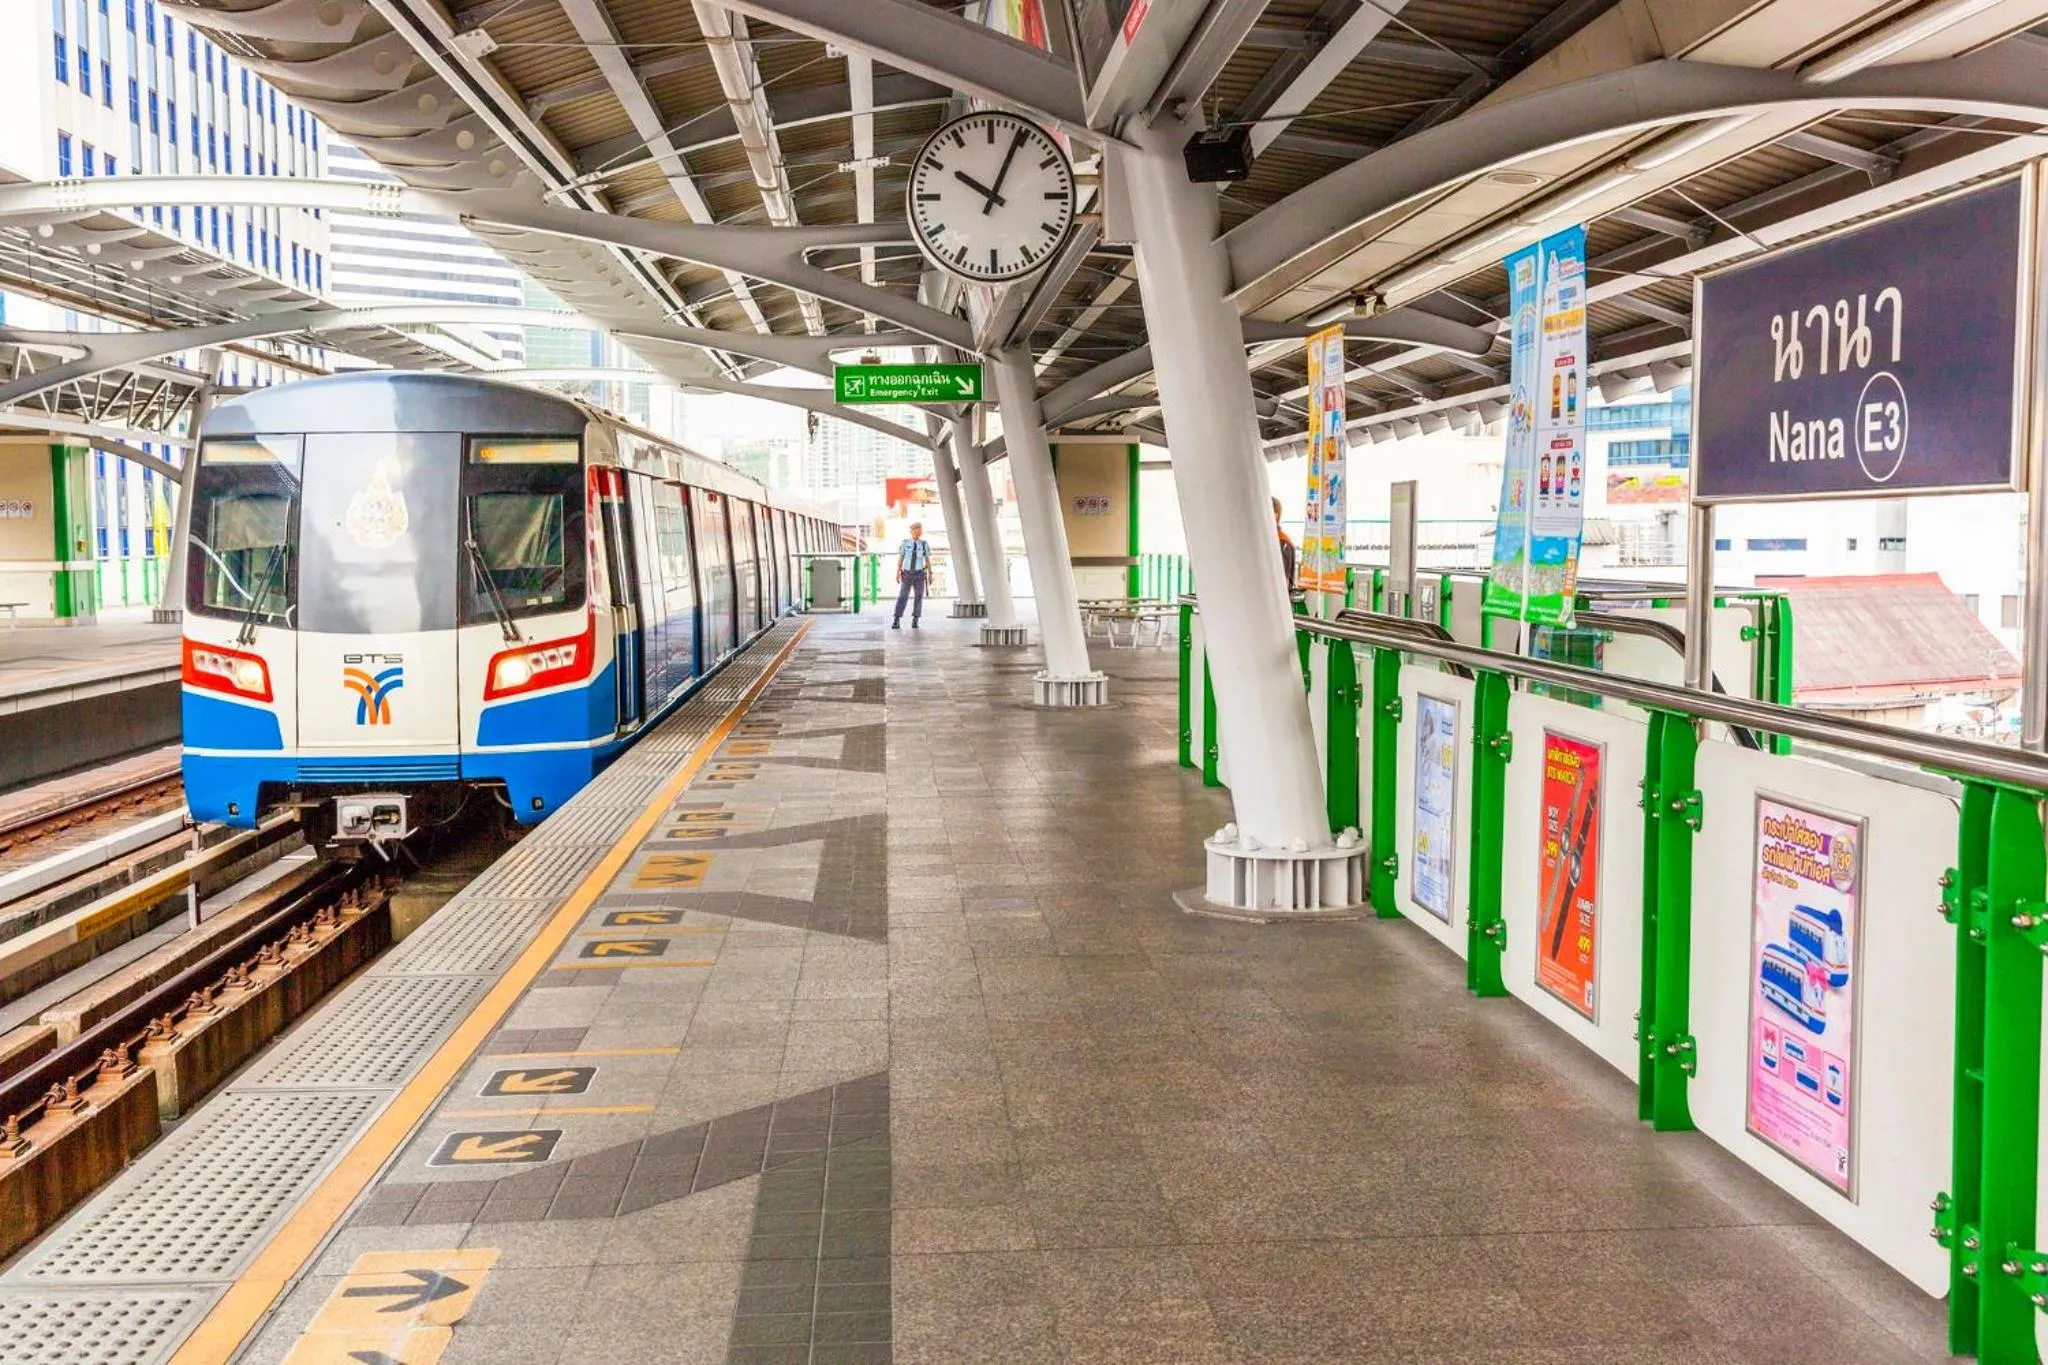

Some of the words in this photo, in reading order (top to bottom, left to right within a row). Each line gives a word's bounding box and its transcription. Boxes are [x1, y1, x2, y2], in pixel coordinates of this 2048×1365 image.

[1771, 287, 1903, 382] นานา
[869, 371, 951, 390] ทางออกฉุกเฉิน
[870, 388, 918, 398] Emergency
[921, 387, 939, 396] Exit
[1769, 410, 1845, 463] Nana
[1864, 401, 1901, 452] E3
[343, 653, 404, 664] BTS
